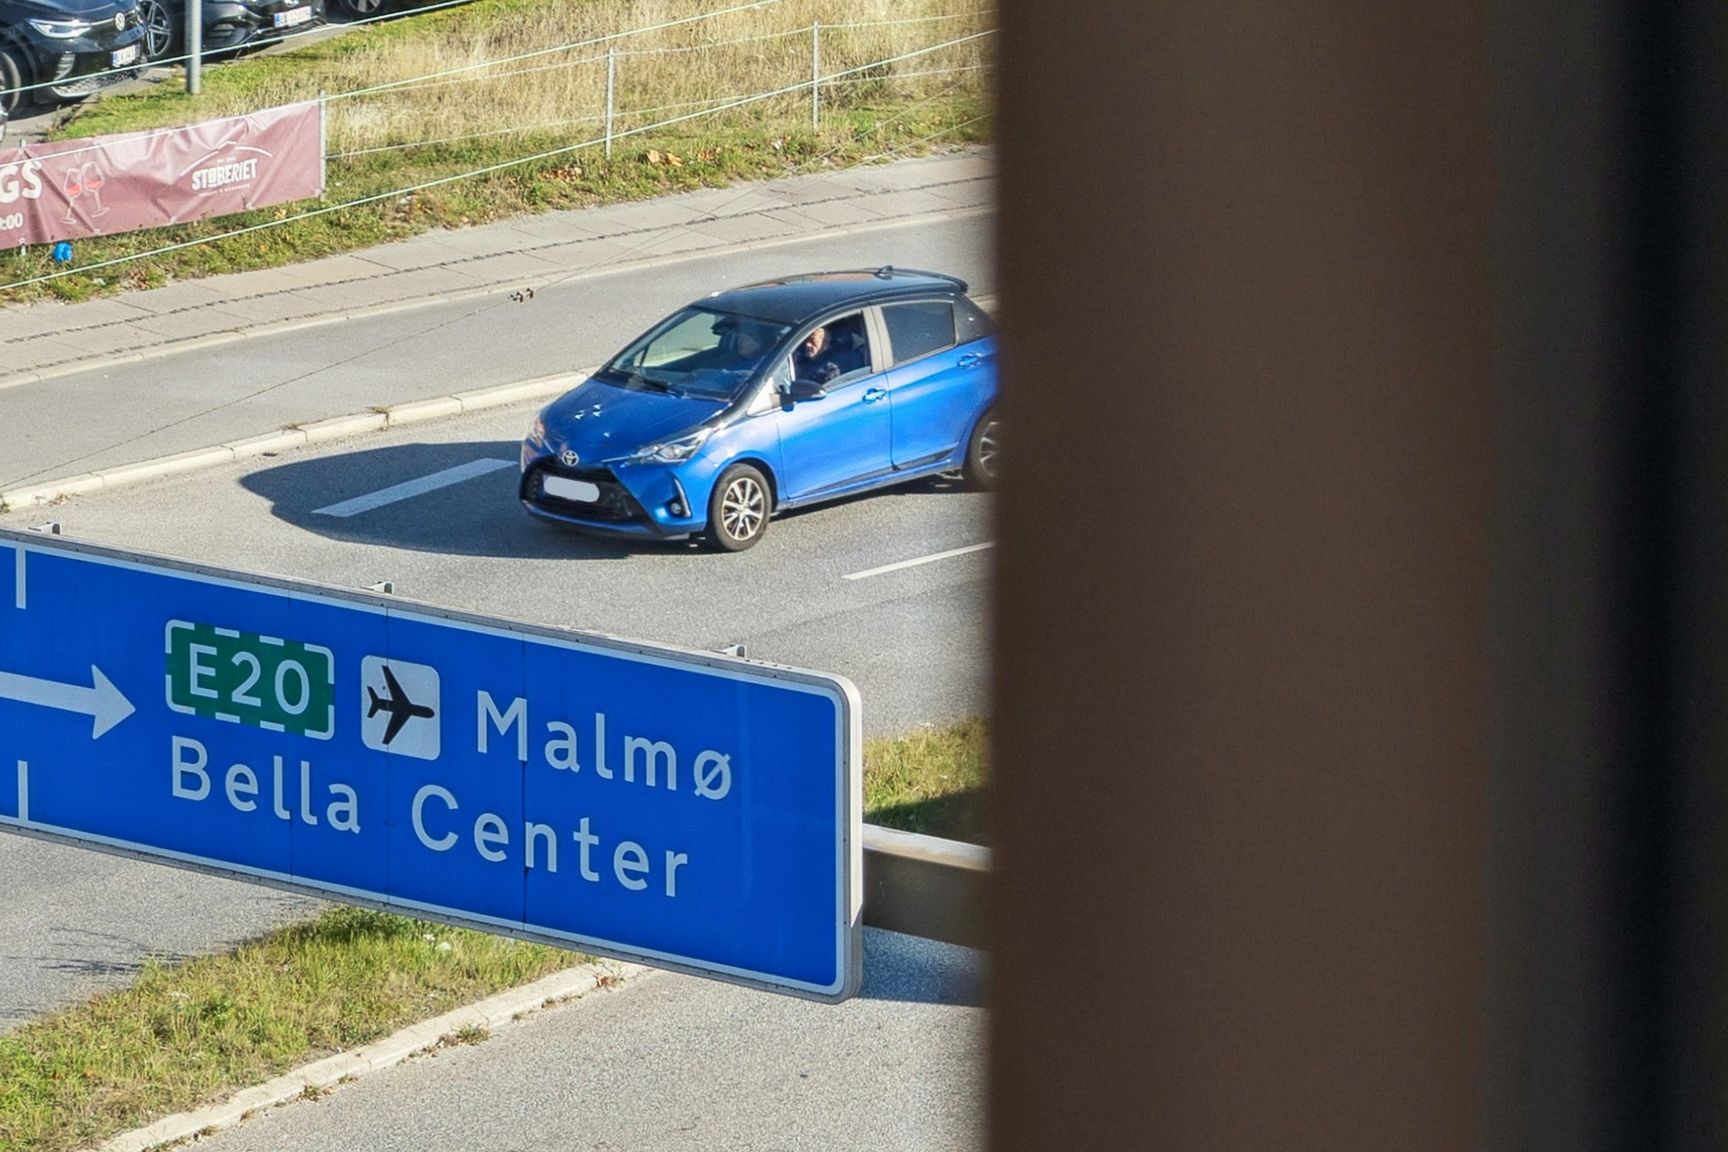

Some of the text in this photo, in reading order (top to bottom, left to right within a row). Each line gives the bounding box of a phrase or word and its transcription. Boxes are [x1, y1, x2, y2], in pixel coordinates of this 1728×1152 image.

[189, 642, 310, 715] E20
[477, 689, 732, 800] Malmø
[172, 736, 688, 898] Bella Center
